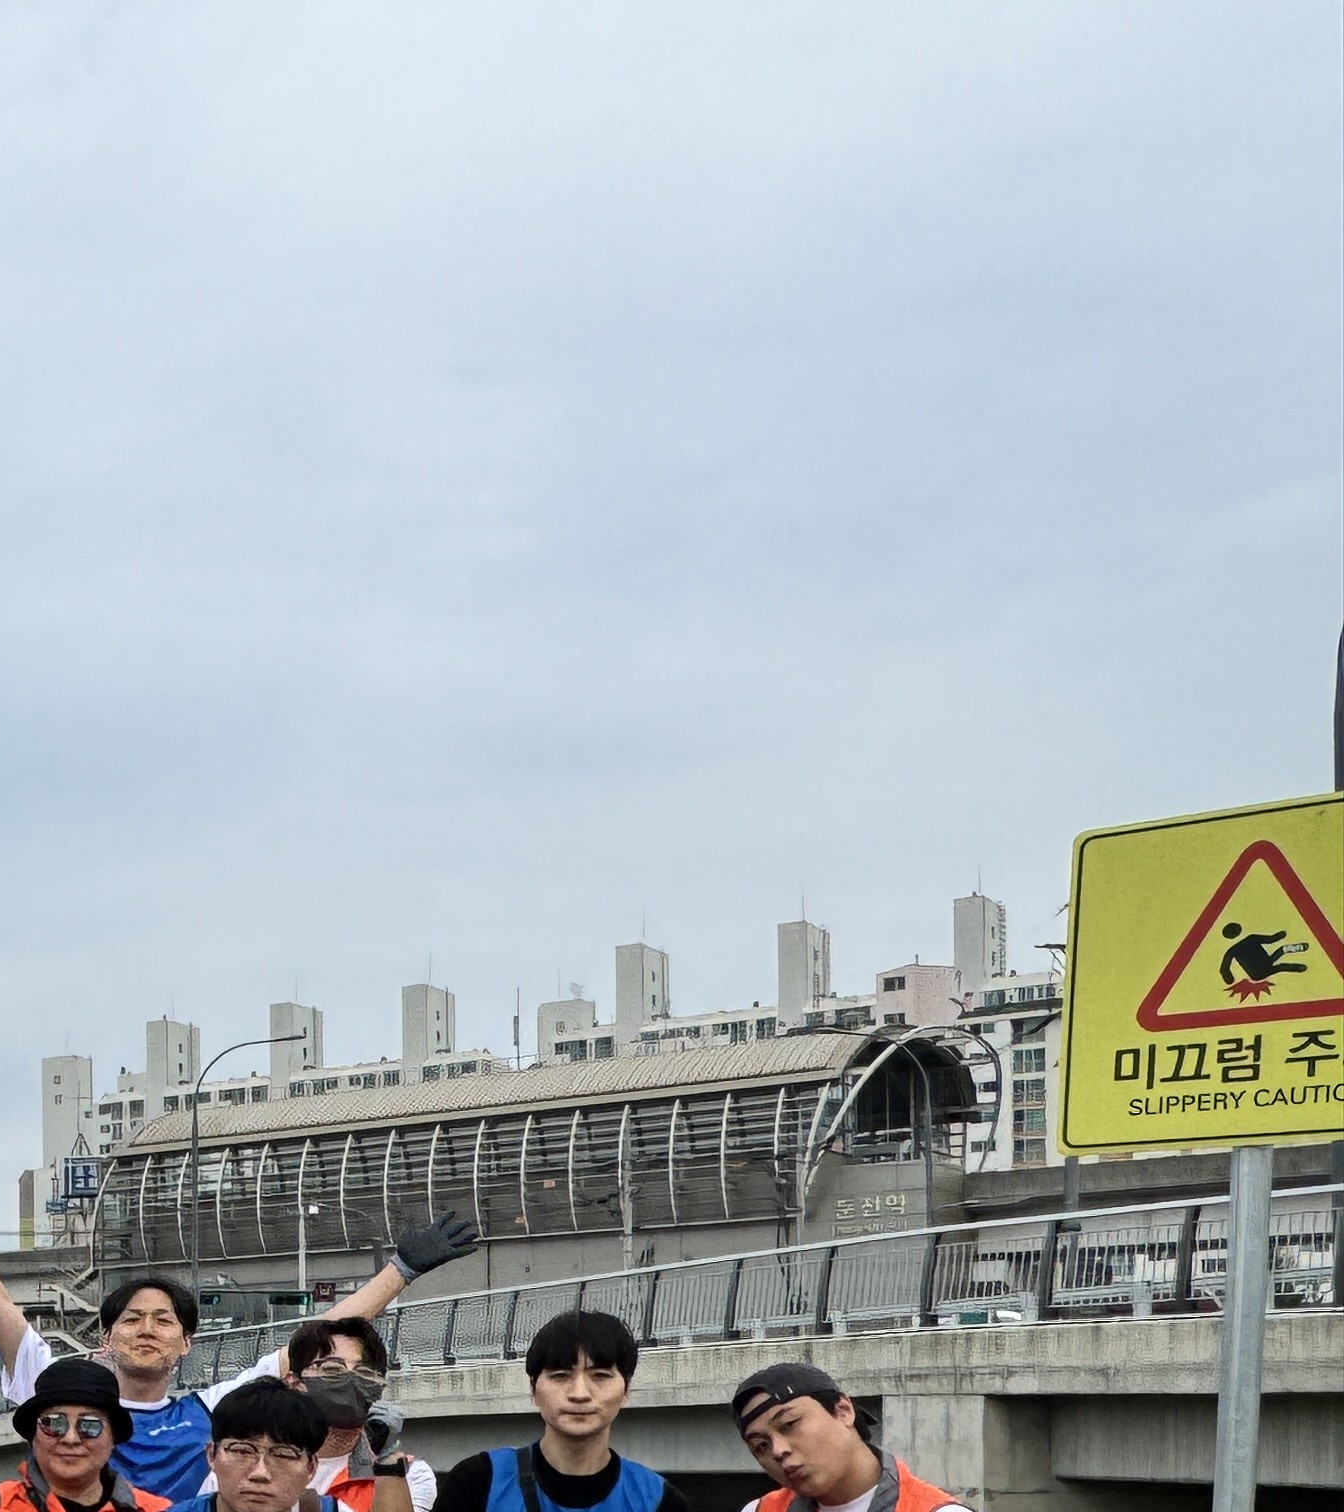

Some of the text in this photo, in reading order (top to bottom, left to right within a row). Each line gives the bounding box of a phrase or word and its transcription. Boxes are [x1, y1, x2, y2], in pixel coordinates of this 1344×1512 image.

[1113, 1029, 1344, 1090] 미끄럼 주
[1128, 1090, 1246, 1117] SLIPPERY
